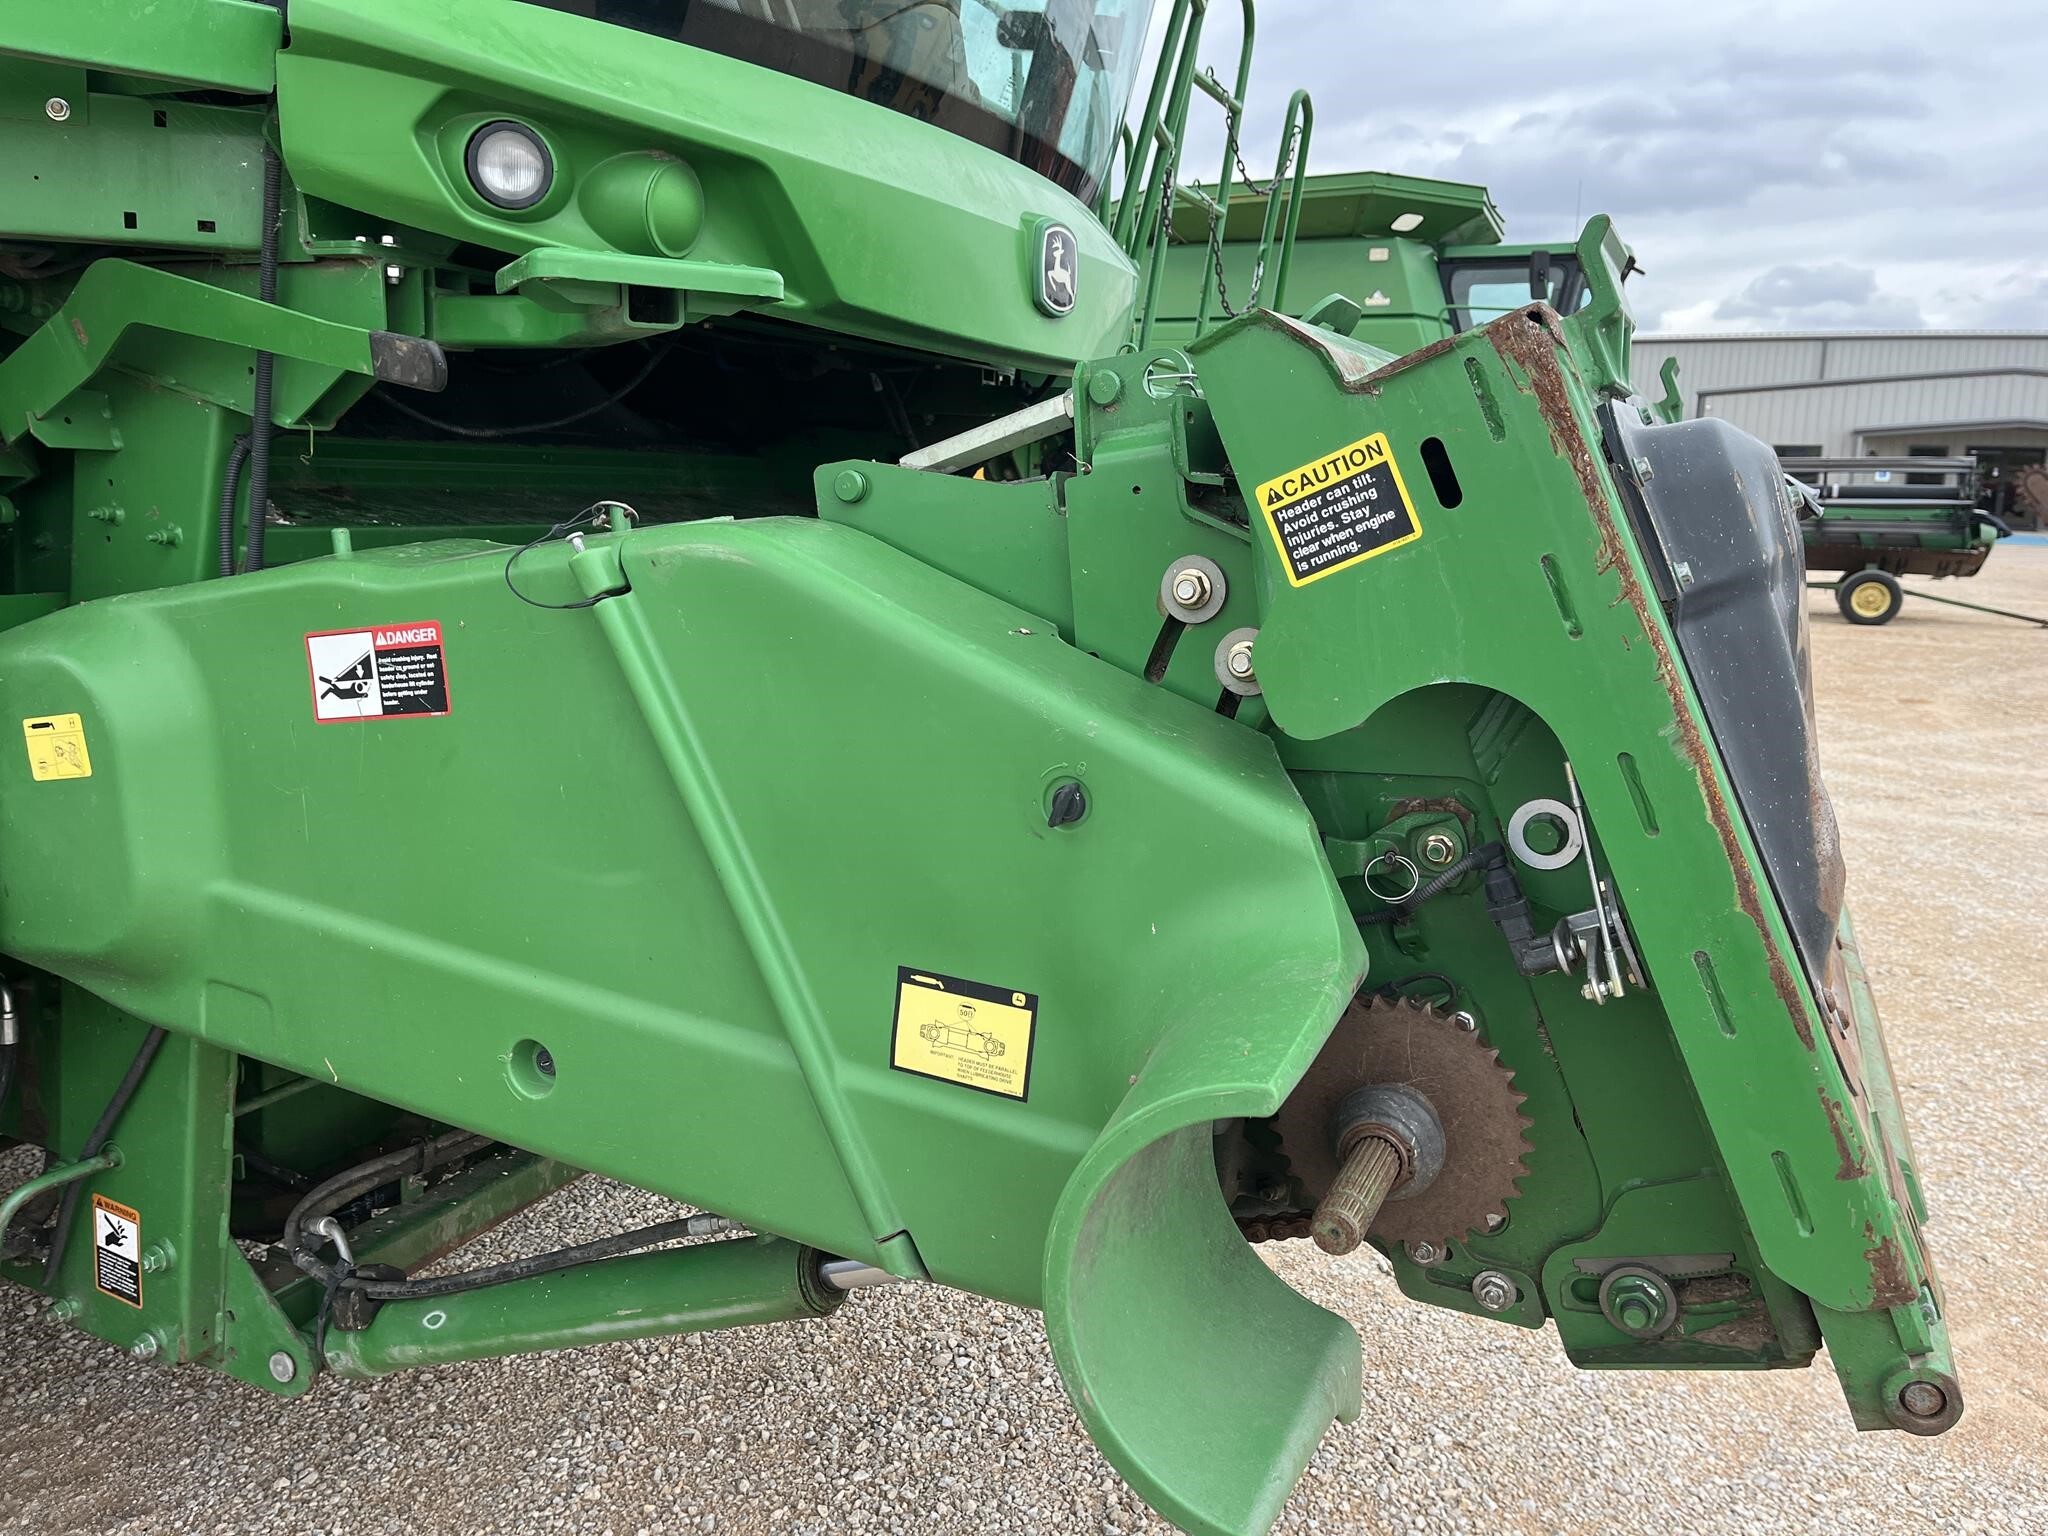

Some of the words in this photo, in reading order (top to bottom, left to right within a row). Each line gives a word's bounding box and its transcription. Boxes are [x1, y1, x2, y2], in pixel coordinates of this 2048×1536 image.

[1282, 439, 1384, 497] CAUTION
[1277, 495, 1323, 522] Header
[1326, 483, 1350, 501] can
[1352, 473, 1376, 489] tilt.
[1283, 511, 1319, 534] Avoid
[1321, 487, 1378, 518] crushing
[1287, 520, 1339, 547] injuries.
[1341, 504, 1370, 525] Stay
[1292, 541, 1320, 559] clear
[1322, 528, 1354, 547] when
[1355, 509, 1396, 533] engine
[1297, 561, 1309, 572] is
[1310, 541, 1361, 567] running.
[386, 627, 437, 645] DANGER
[103, 1200, 137, 1221] WARNING
